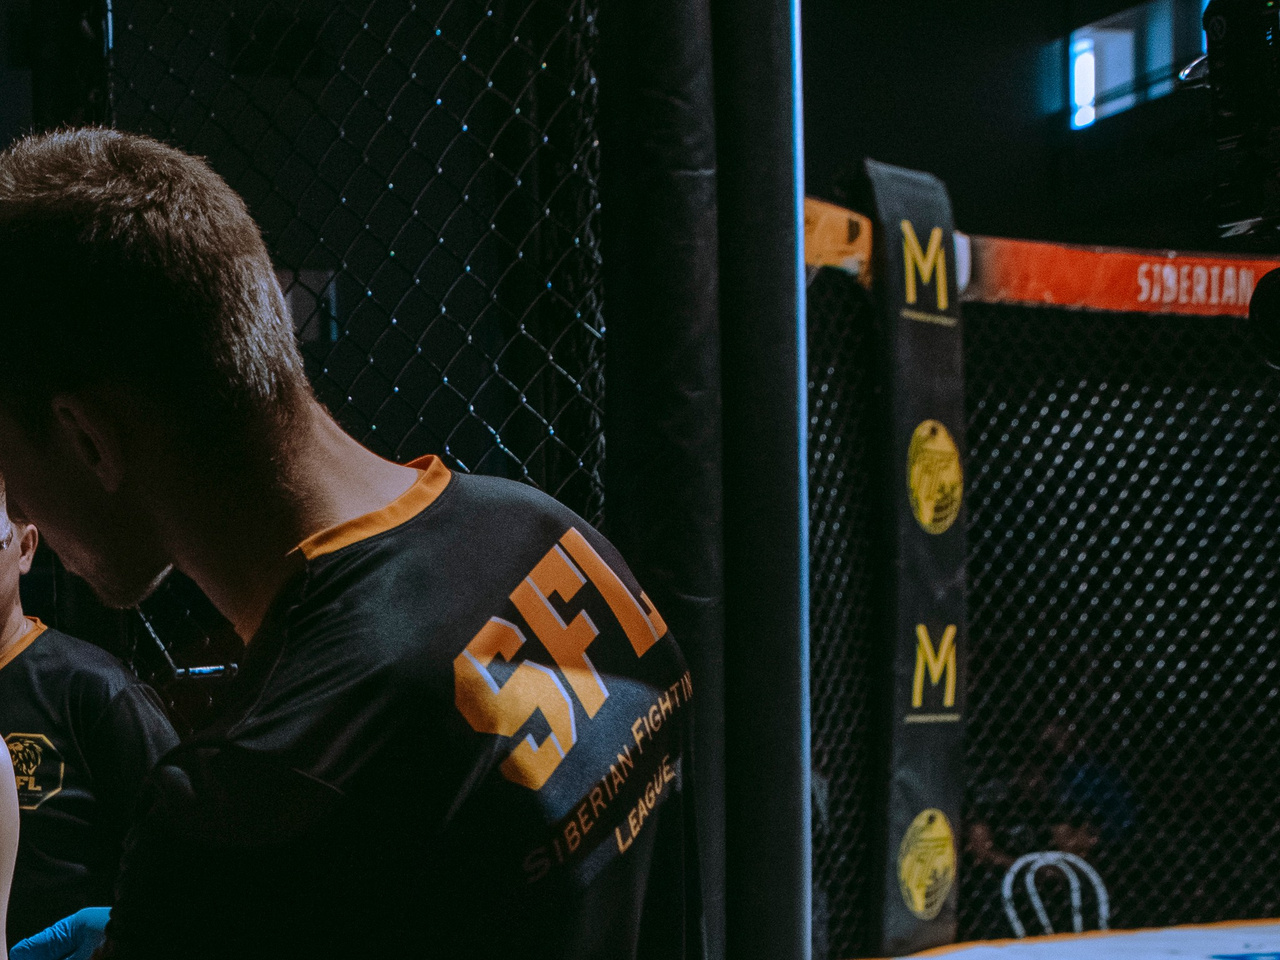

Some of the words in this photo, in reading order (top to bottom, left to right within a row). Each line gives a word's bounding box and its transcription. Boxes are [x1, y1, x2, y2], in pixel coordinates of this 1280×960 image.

[900, 220, 949, 311] M
[1137, 262, 1255, 306] SIBERIAN
[911, 623, 958, 709] M
[15, 775, 43, 791] FL
[521, 744, 634, 884] SIBERIAN
[630, 670, 694, 754] FIGHTIN
[615, 754, 677, 854] LEAGUE
